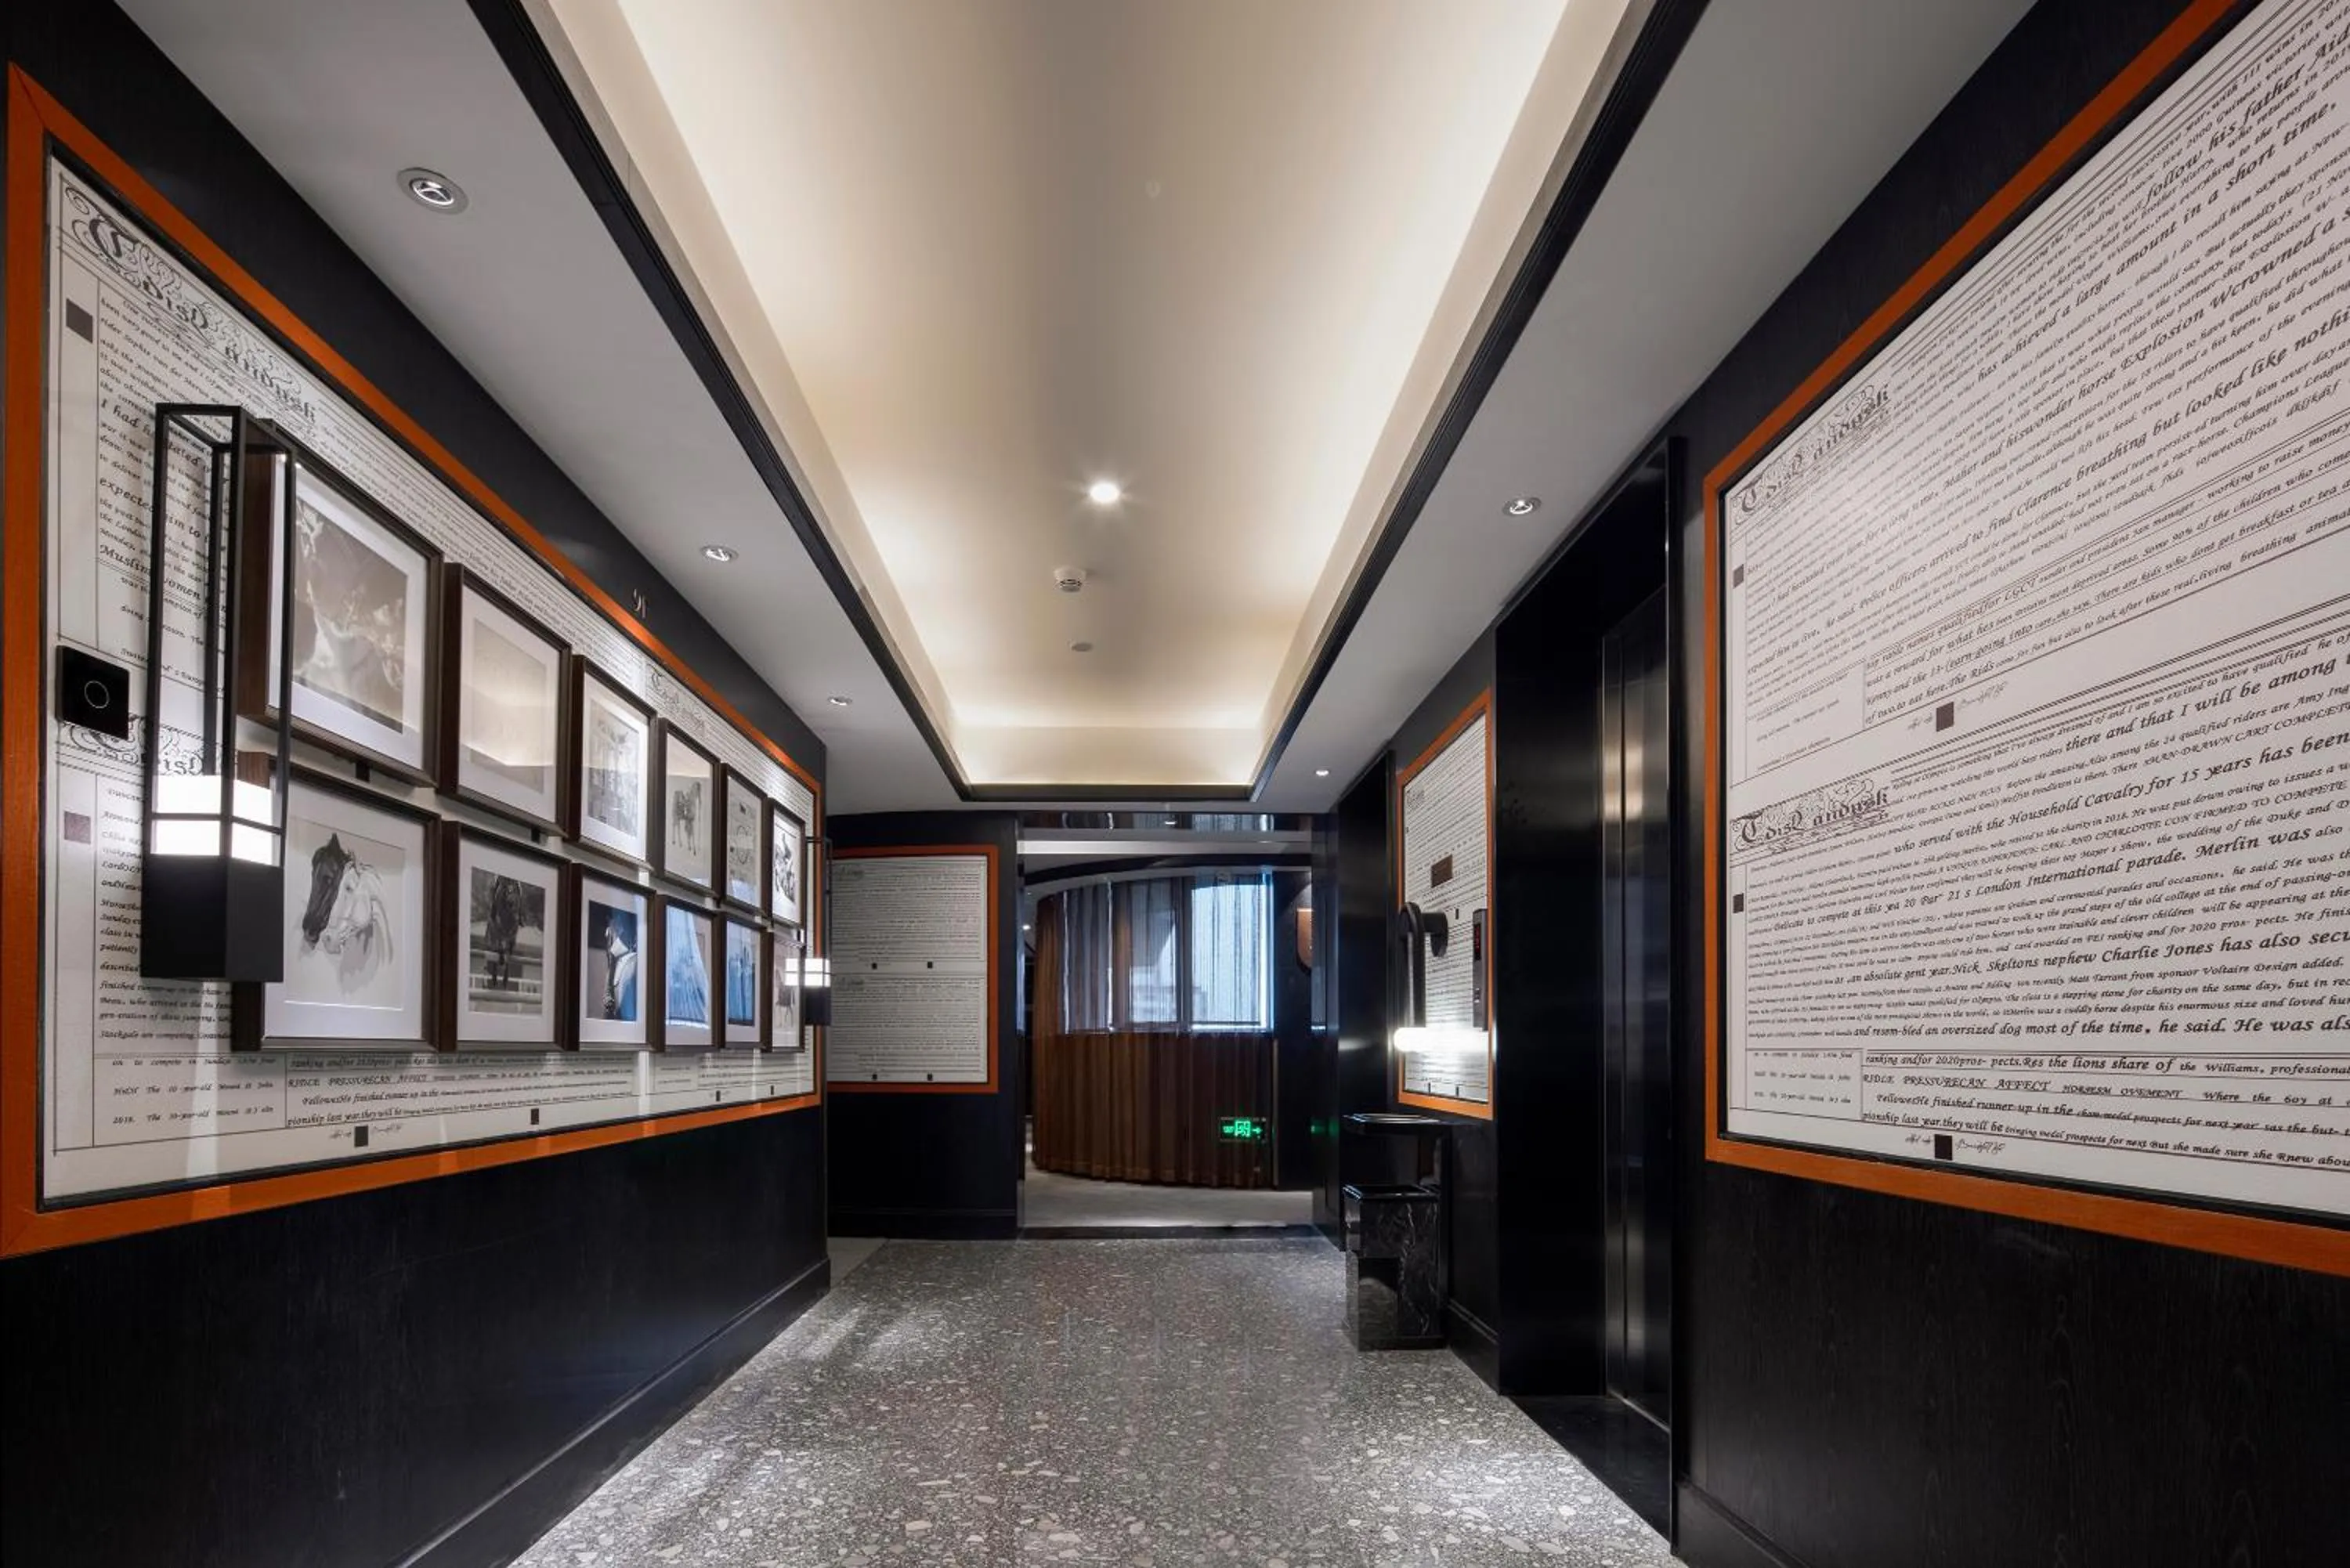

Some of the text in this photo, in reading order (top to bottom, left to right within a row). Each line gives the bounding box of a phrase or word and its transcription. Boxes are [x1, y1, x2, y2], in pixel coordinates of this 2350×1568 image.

[2142, 150, 2203, 209] follow
[2208, 121, 2236, 152] his
[2238, 63, 2305, 131] father
[2075, 273, 2111, 307] large
[2116, 221, 2176, 276] amount
[2183, 203, 2201, 224] in
[2207, 190, 2219, 205] a
[2225, 144, 2275, 191] short
[2078, 367, 2117, 400] horse
[2322, 218, 2335, 235] a
[2077, 432, 2147, 481] breathing
[2153, 412, 2180, 436] but
[2186, 366, 2249, 417] looked
[2251, 348, 2287, 378] like
[2066, 733, 2101, 752] there
[2106, 717, 2138, 740] and
[2140, 709, 2174, 729] that
[2194, 685, 2236, 712] will
[2240, 681, 2261, 698] be
[2268, 658, 2337, 690] among
[1893, 732, 2350, 853] who served with the Household Cavalry for 15 years has been
[1976, 878, 2021, 896] London
[2026, 858, 2124, 887] International
[2196, 836, 2259, 858] Merlin
[2268, 828, 2312, 845] was
[2316, 825, 2343, 837] also
[2044, 950, 2097, 968] nephew
[2102, 945, 2159, 963] Charlie
[2163, 943, 2214, 958] Jones
[2220, 936, 2253, 952] has
[2258, 932, 2301, 948] also
[1941, 1022, 1999, 1035] oversized
[1998, 1022, 2022, 1036] dog
[2026, 1024, 2058, 1035] most
[2061, 1021, 2078, 1036] of
[2081, 1020, 2104, 1034] the
[2158, 1018, 2178, 1033] he
[2233, 1017, 2263, 1032] He
[2269, 1021, 2315, 1031] was
[2048, 1056, 2196, 1074] the lions share of the
[1965, 1120, 1989, 1131] will
[2193, 1145, 2221, 1155] made
[2224, 1149, 2250, 1158] sure
[2252, 1149, 2272, 1160] she
[2252, 1093, 2271, 1102] the
[2318, 1097, 2332, 1106] at
